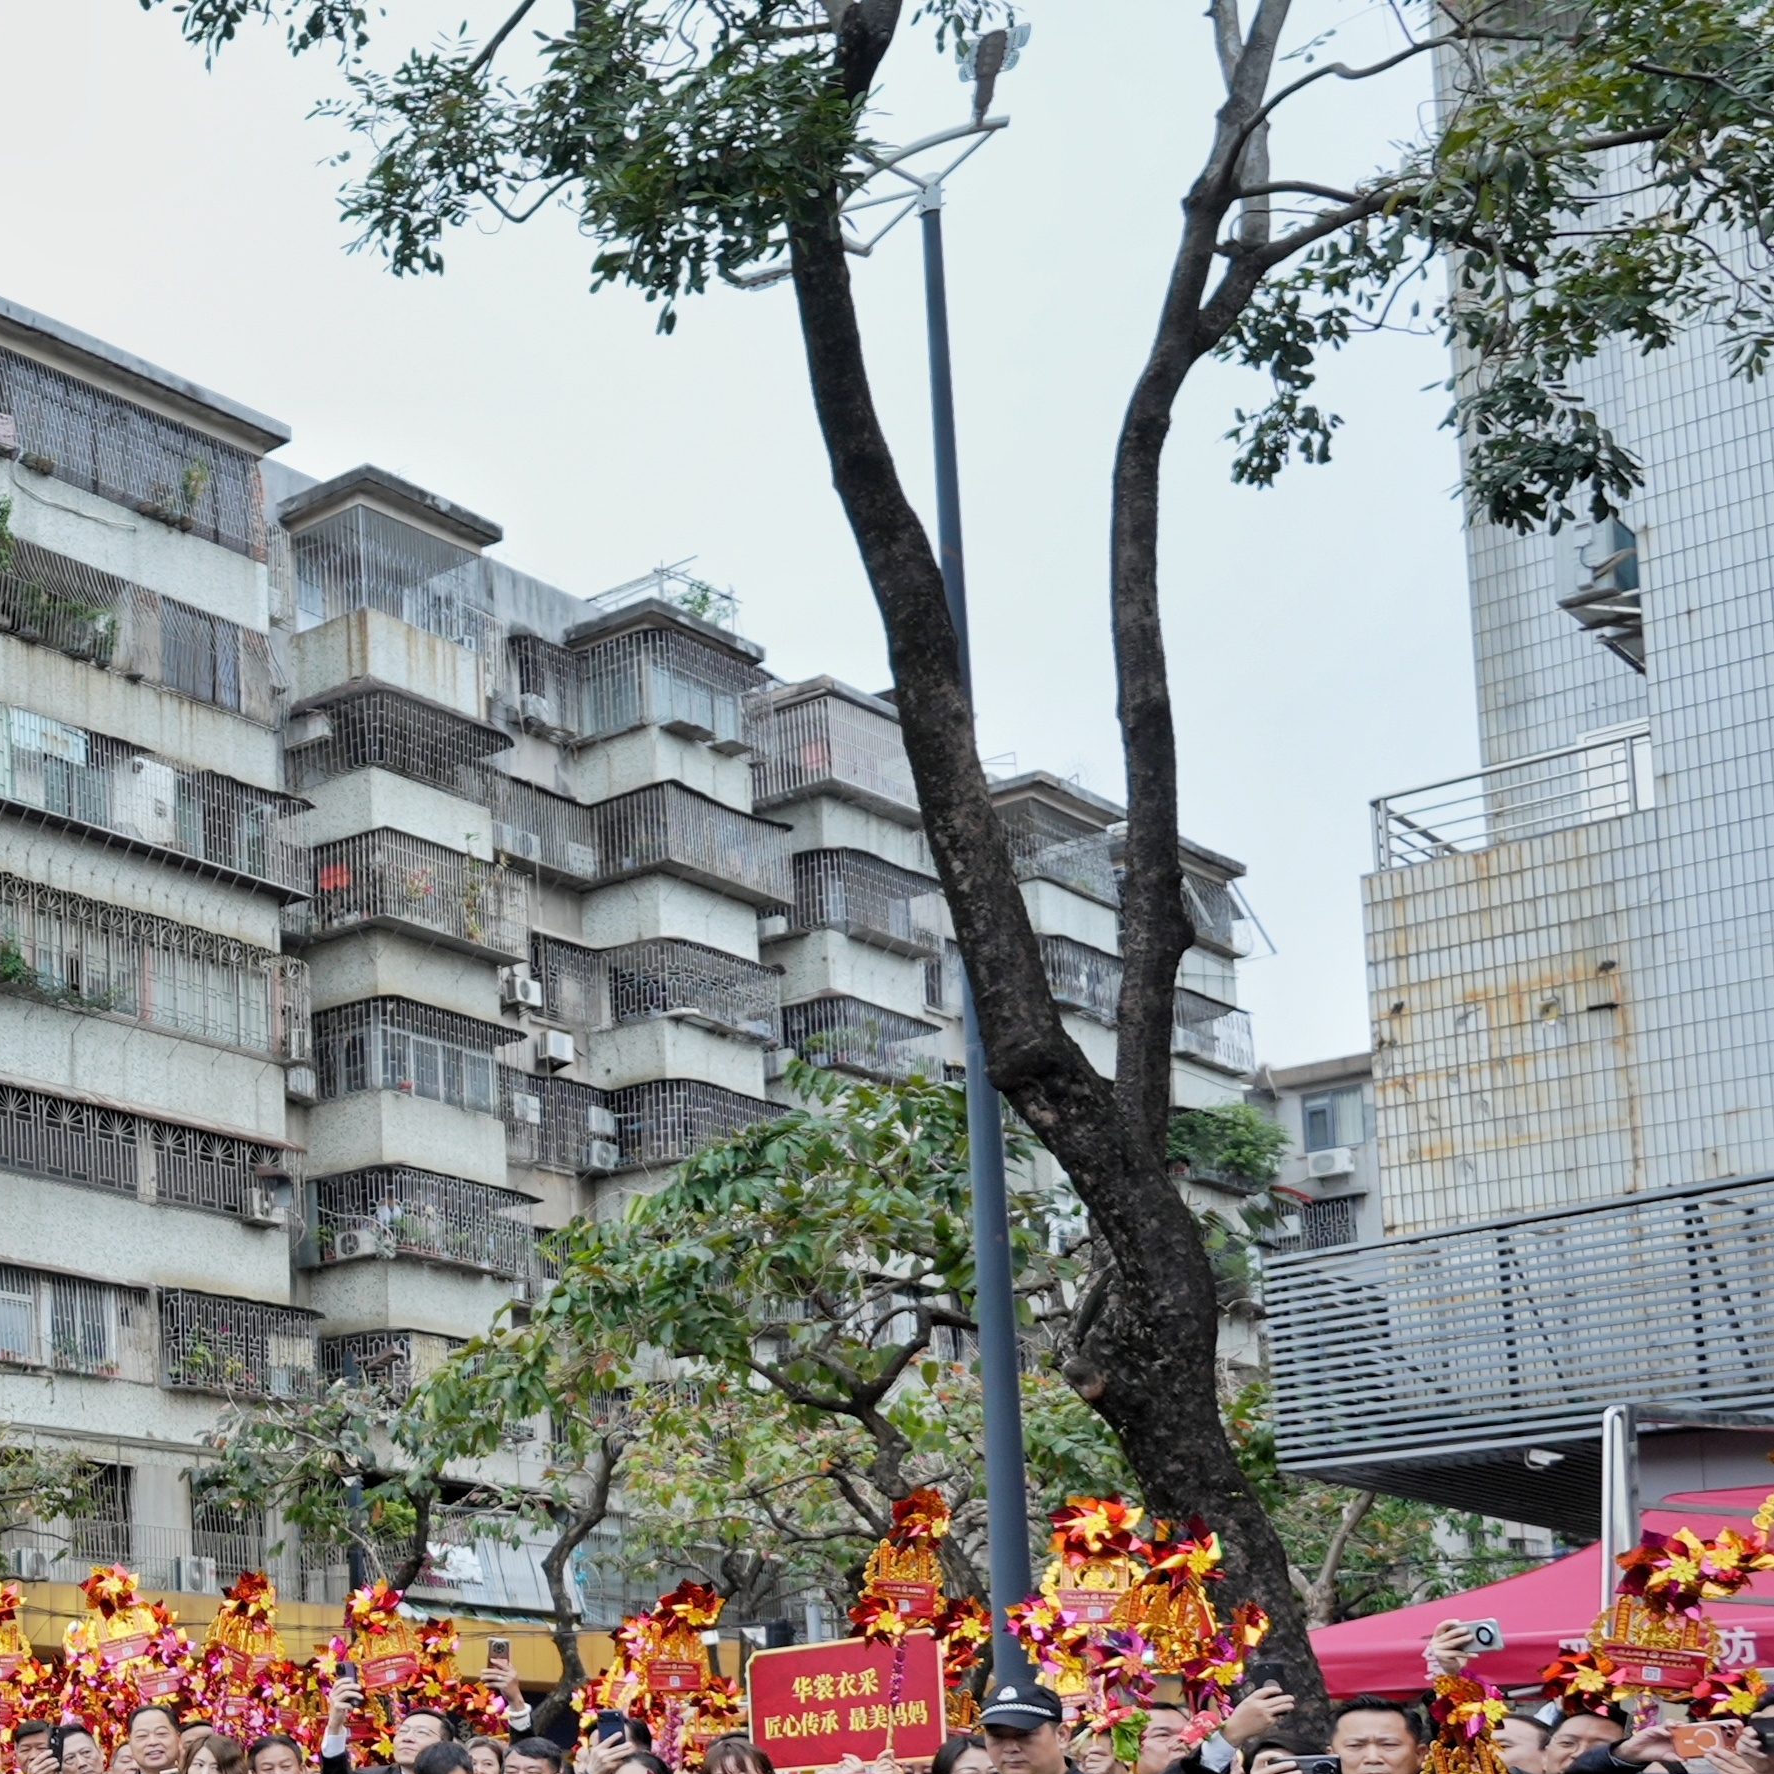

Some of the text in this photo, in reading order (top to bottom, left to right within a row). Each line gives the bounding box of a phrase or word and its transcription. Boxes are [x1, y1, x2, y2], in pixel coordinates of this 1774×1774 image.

[791, 1667, 879, 1704] 华裳衣采
[764, 1709, 840, 1740] 匠心传承
